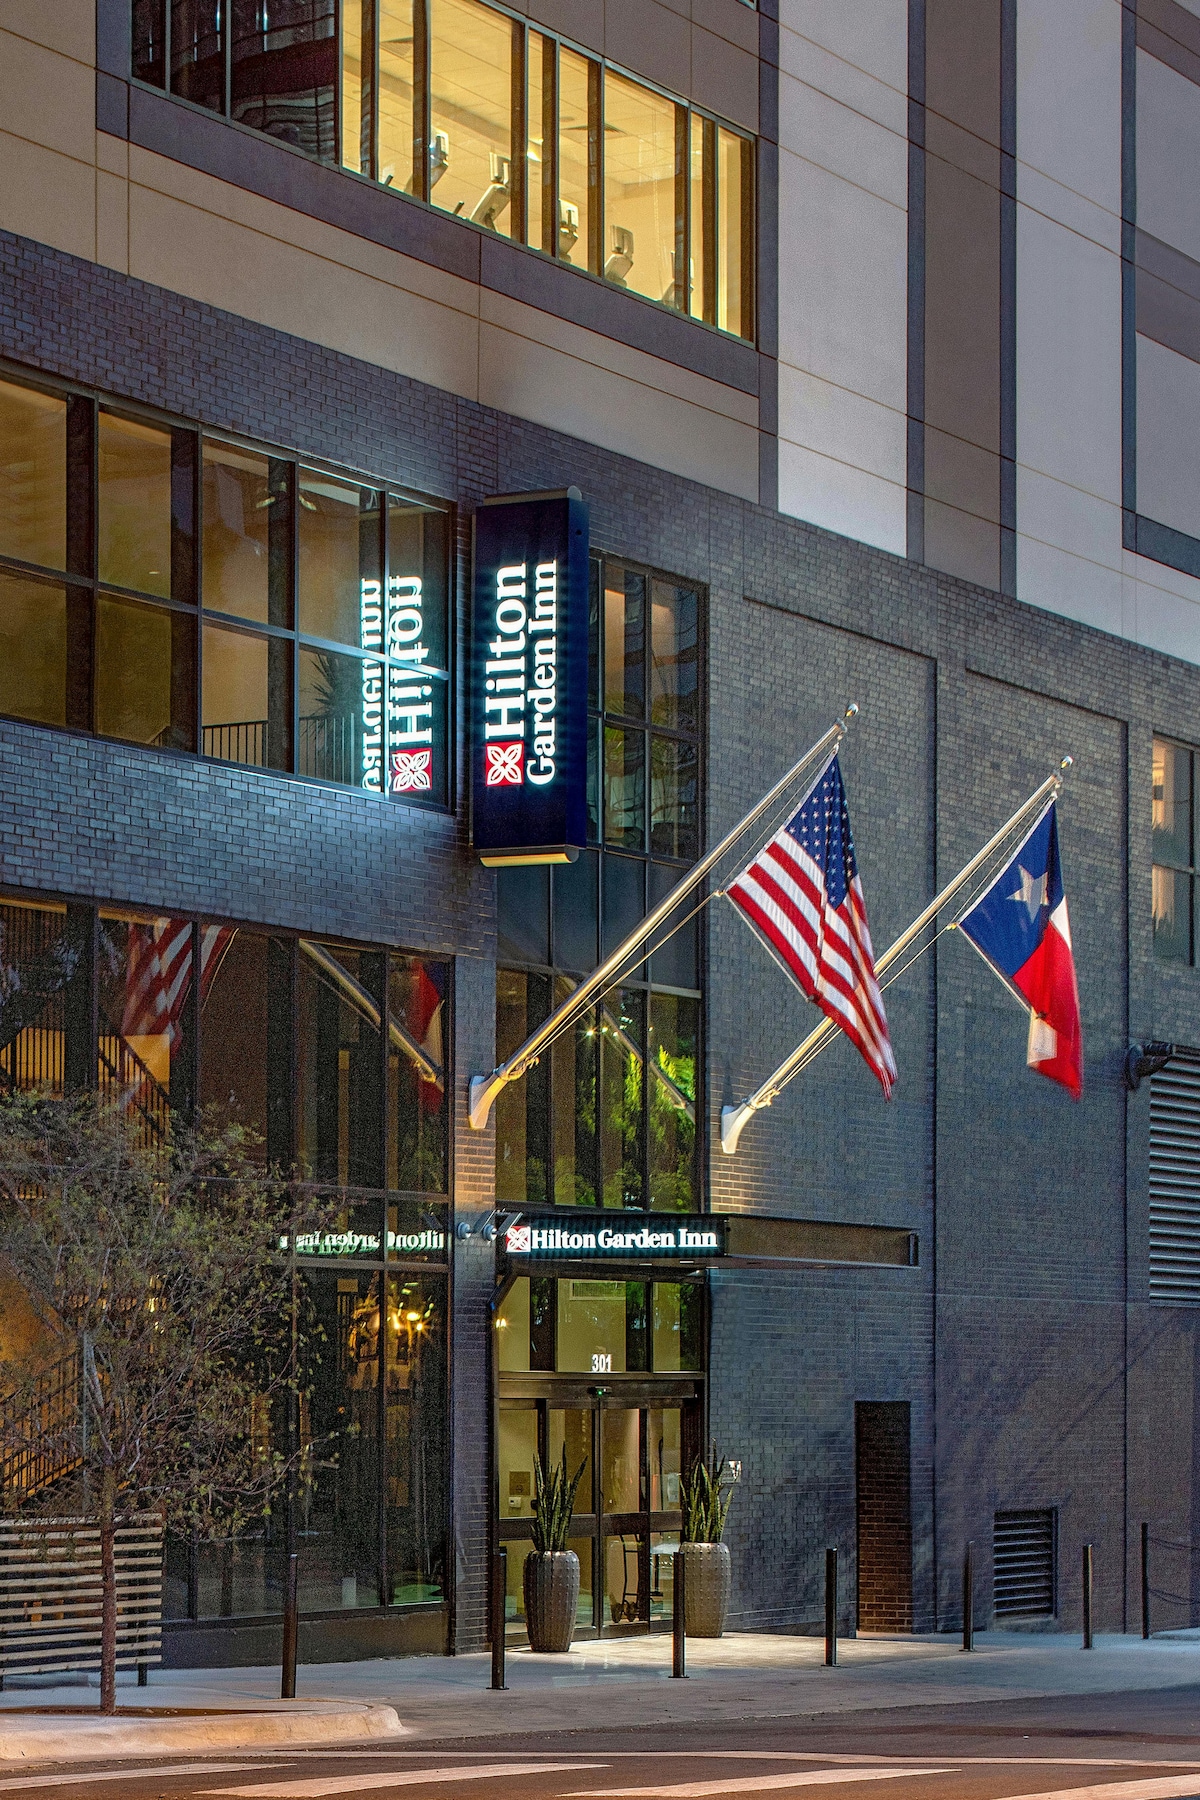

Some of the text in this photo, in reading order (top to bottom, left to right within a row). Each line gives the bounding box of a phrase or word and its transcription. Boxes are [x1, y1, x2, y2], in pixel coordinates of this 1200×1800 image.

[485, 562, 527, 740] Hilton
[526, 559, 558, 786] Garden Inn
[531, 1229, 718, 1249] Hilton Garden Inn
[591, 1353, 613, 1373] 301
